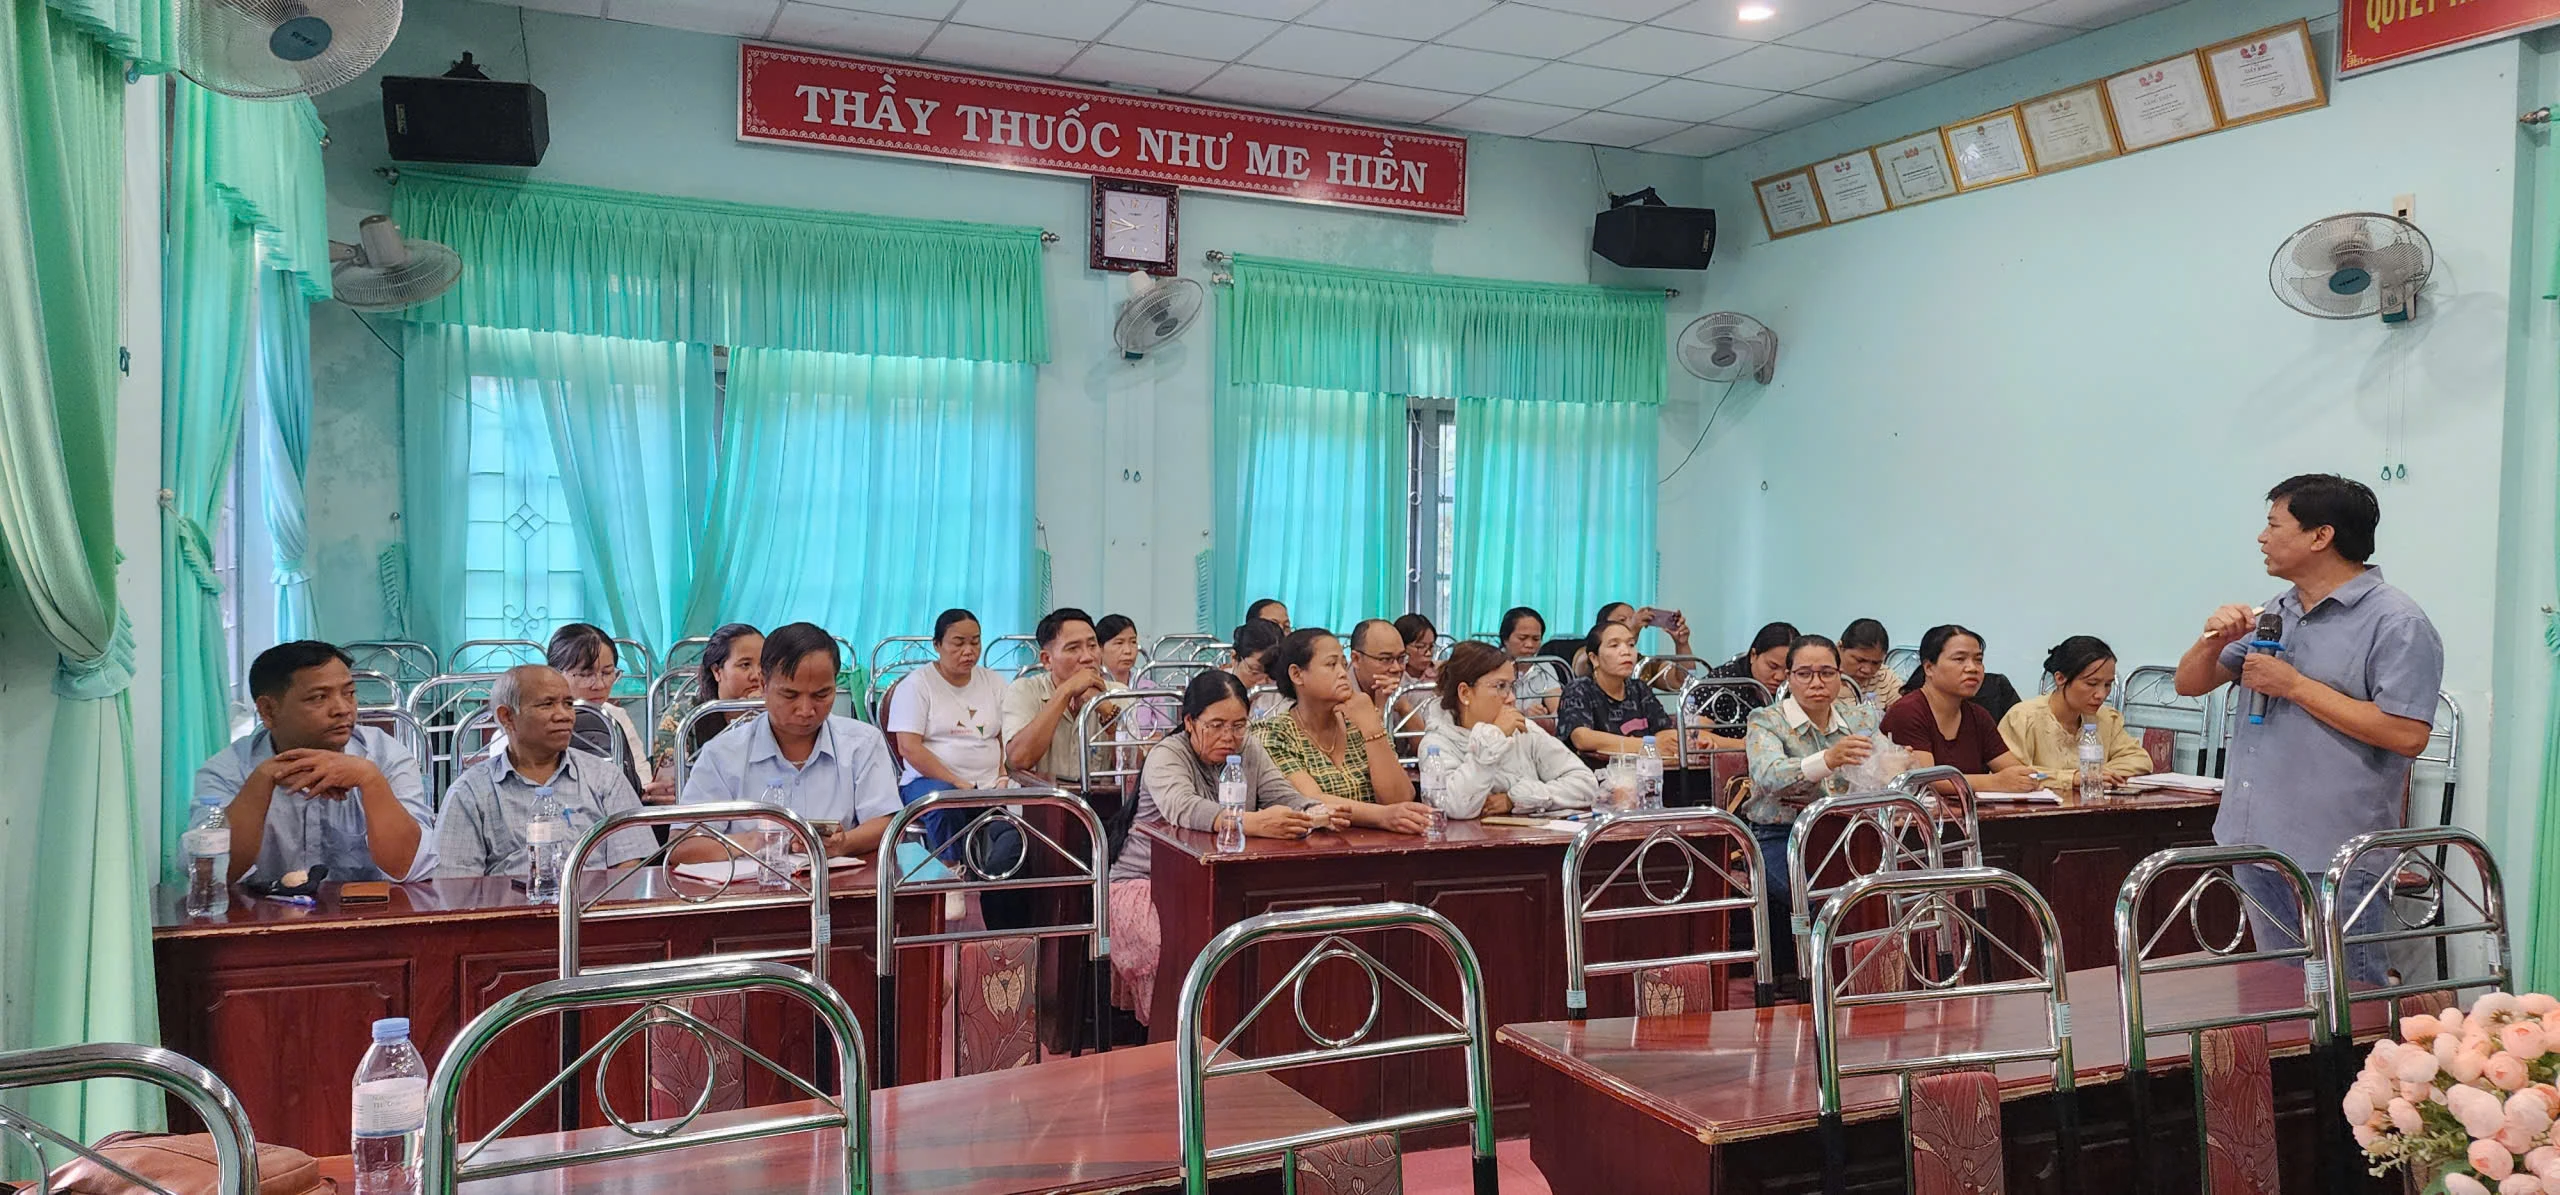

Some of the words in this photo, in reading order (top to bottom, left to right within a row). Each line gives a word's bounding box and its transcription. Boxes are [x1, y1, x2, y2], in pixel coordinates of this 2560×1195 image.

[795, 73, 940, 136] THẦY
[955, 102, 1121, 158] THUỐC
[1137, 127, 1234, 171] NHƯ
[1245, 142, 1311, 189] MẸ
[1325, 138, 1428, 194] HIỀN
